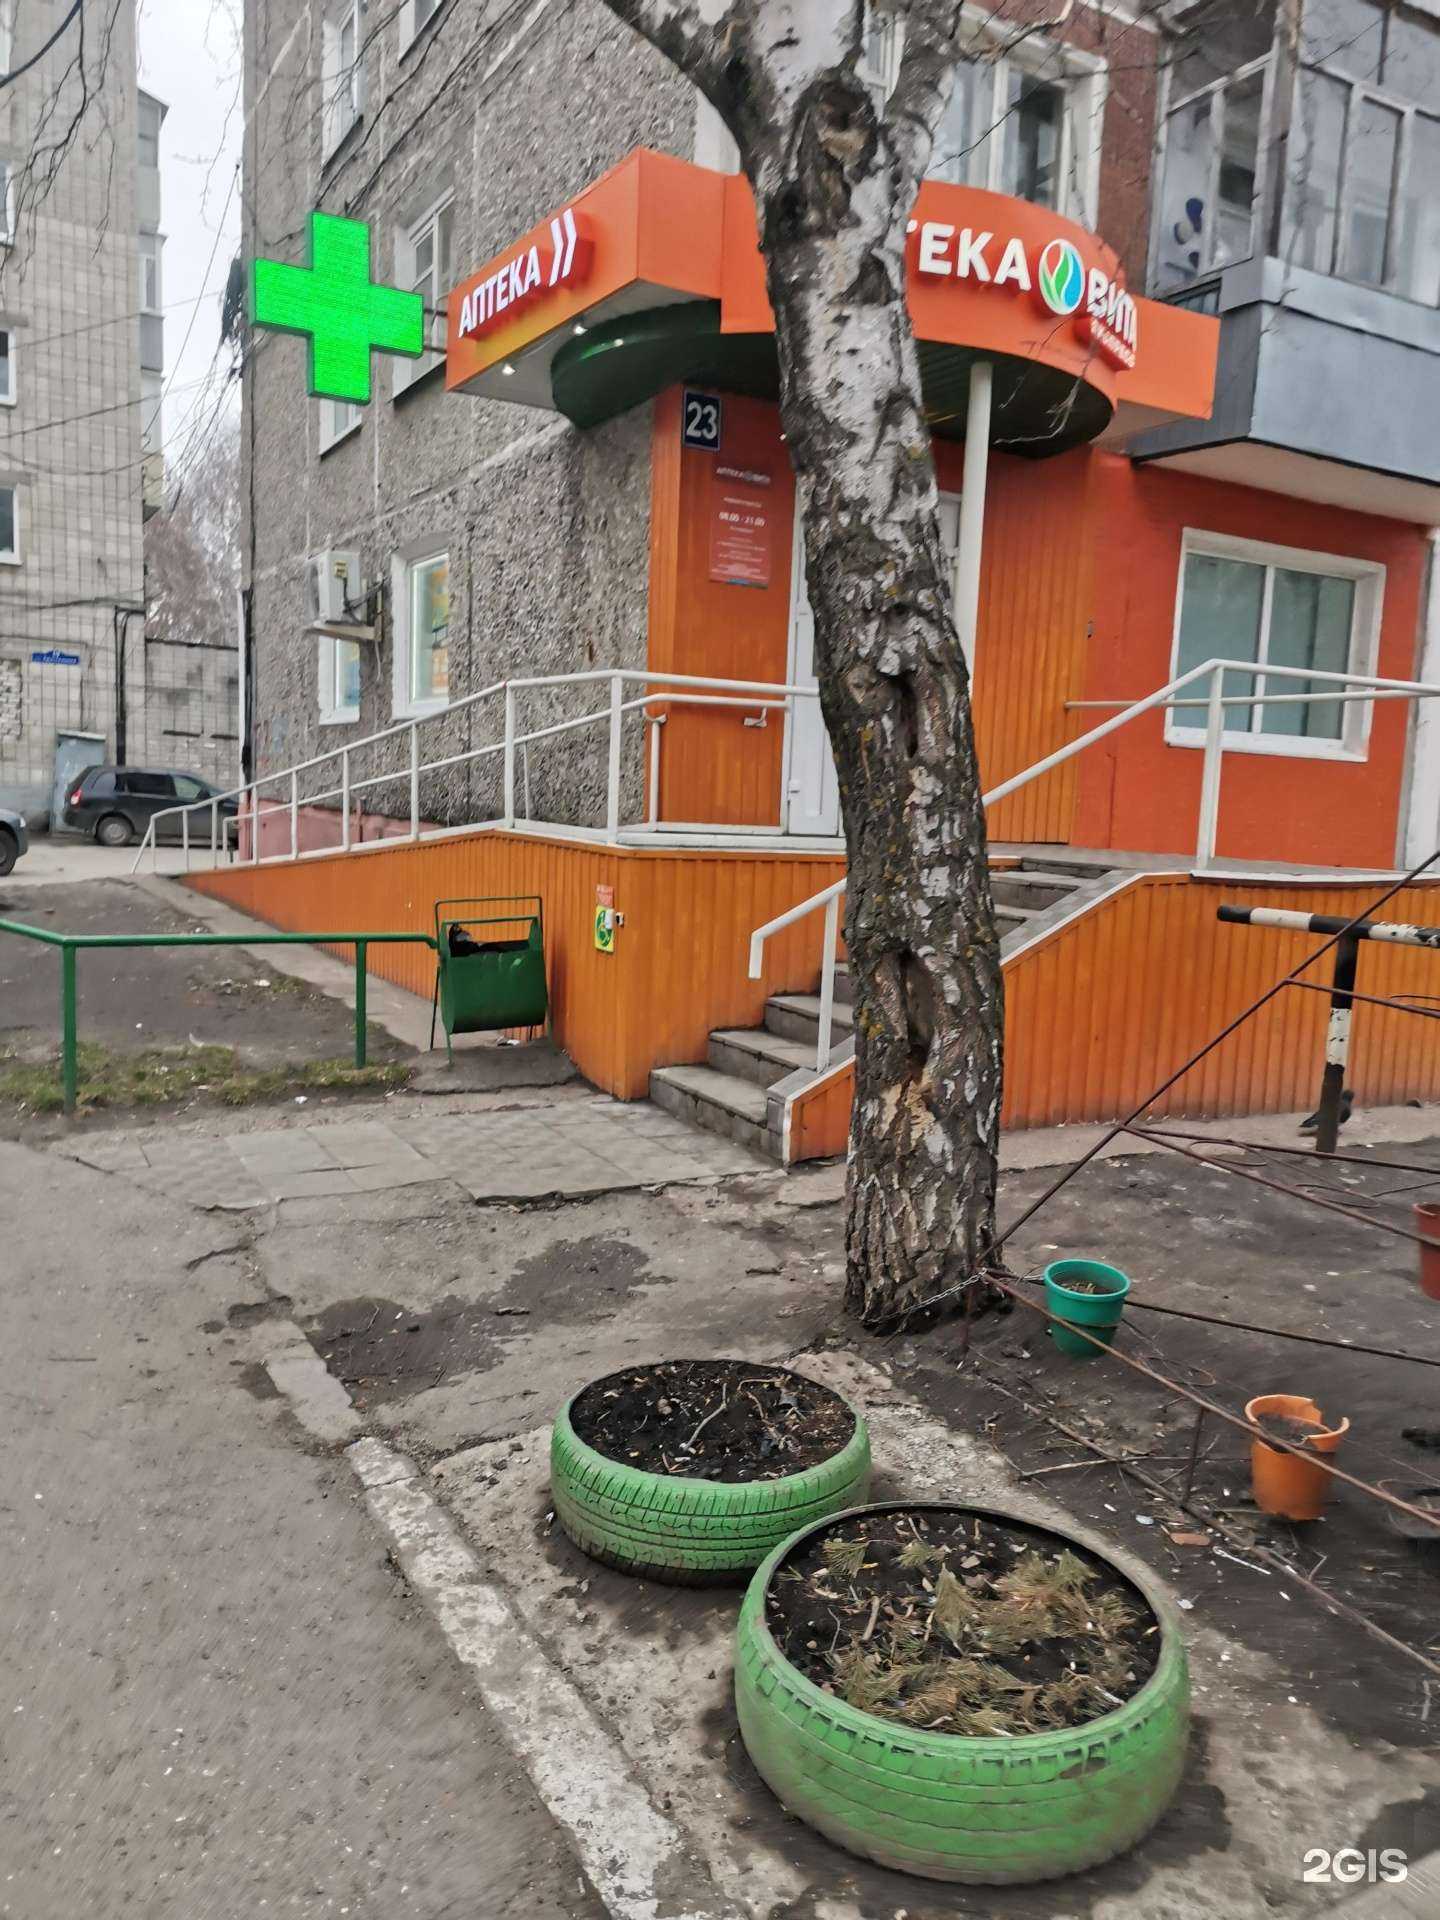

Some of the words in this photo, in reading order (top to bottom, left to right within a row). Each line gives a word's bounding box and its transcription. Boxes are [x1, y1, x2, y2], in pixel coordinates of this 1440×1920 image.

[458, 245, 542, 338] АПТЕКА
[906, 219, 1032, 292] ЕКА
[686, 401, 718, 440] 23
